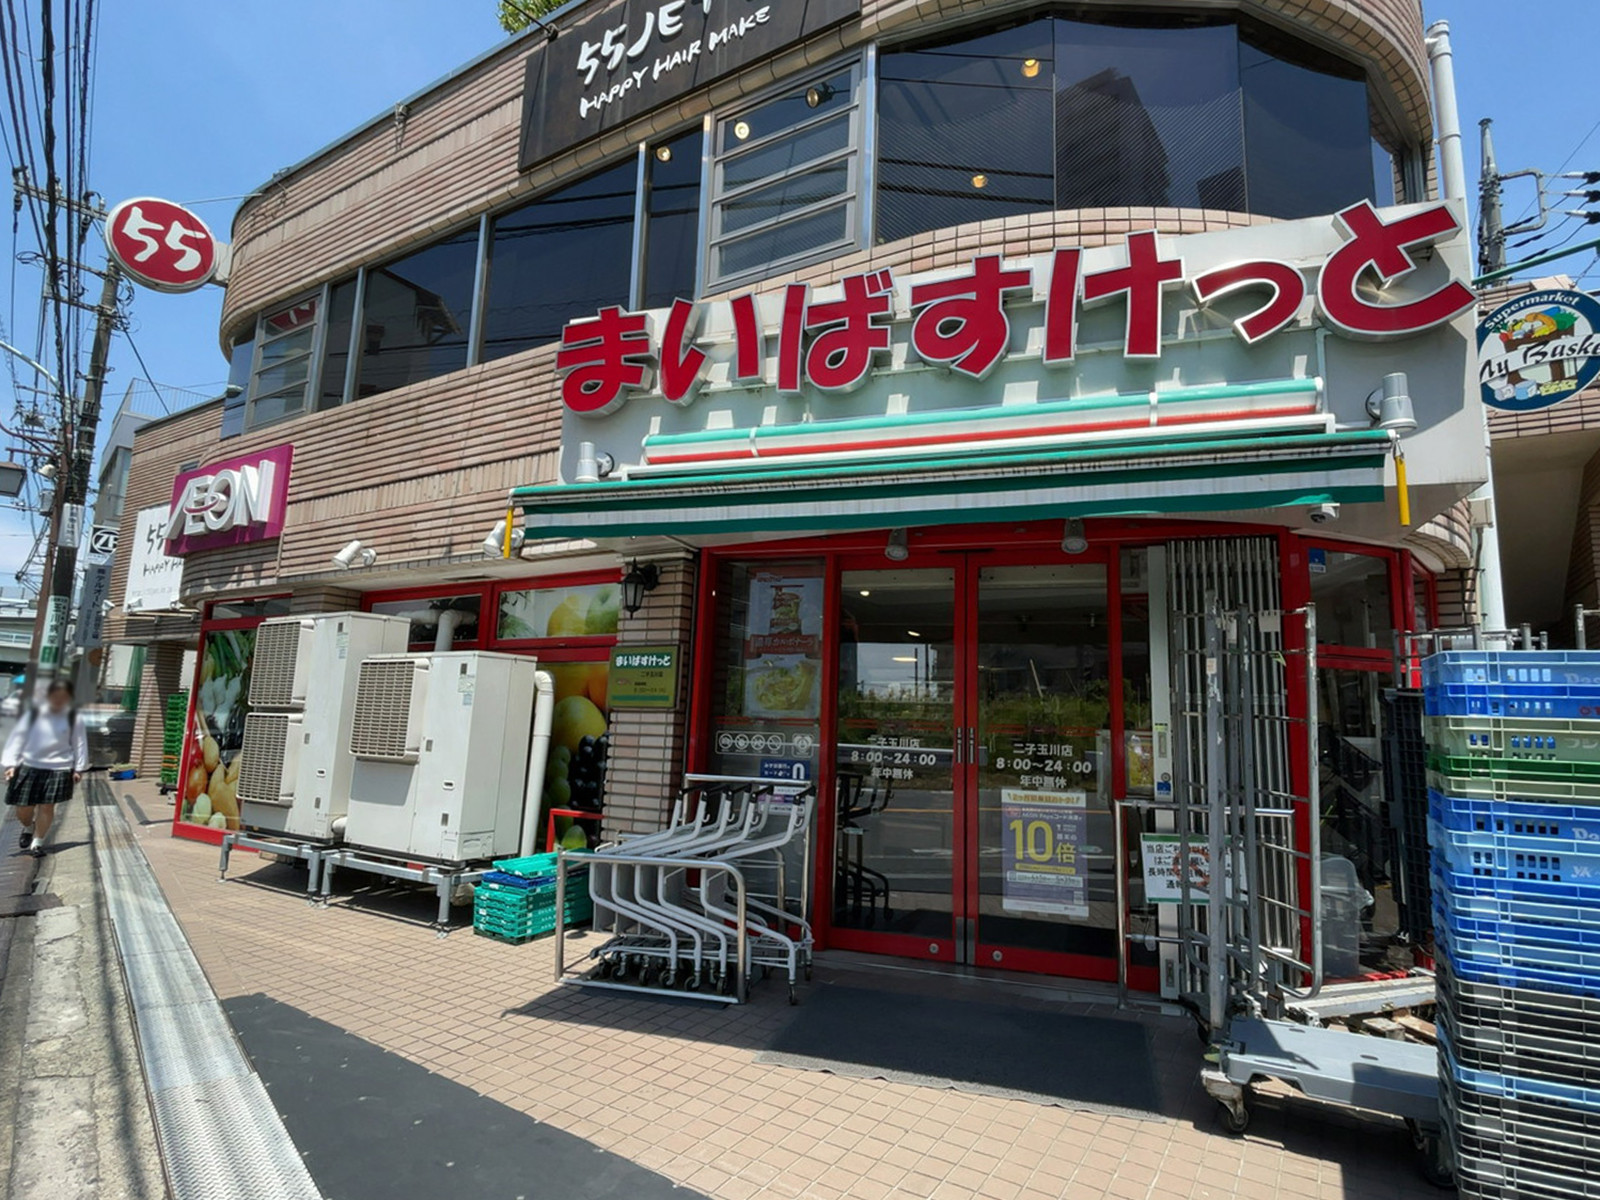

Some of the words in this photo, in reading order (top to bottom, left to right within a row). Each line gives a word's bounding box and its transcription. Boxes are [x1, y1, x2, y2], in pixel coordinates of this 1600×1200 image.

[579, 66, 649, 119] HAPPY
[652, 40, 702, 81] HAIR
[708, 5, 770, 51] MAKE
[122, 206, 206, 271] 55
[556, 198, 1476, 418] まいばすけっと
[1484, 291, 1580, 330] Supermarket
[1480, 358, 1509, 378] My
[615, 654, 671, 667] まいばすけっと
[1012, 742, 1074, 757] 二子玉川店
[870, 767, 914, 780] 年中無休
[1019, 774, 1068, 788] 年中無休
